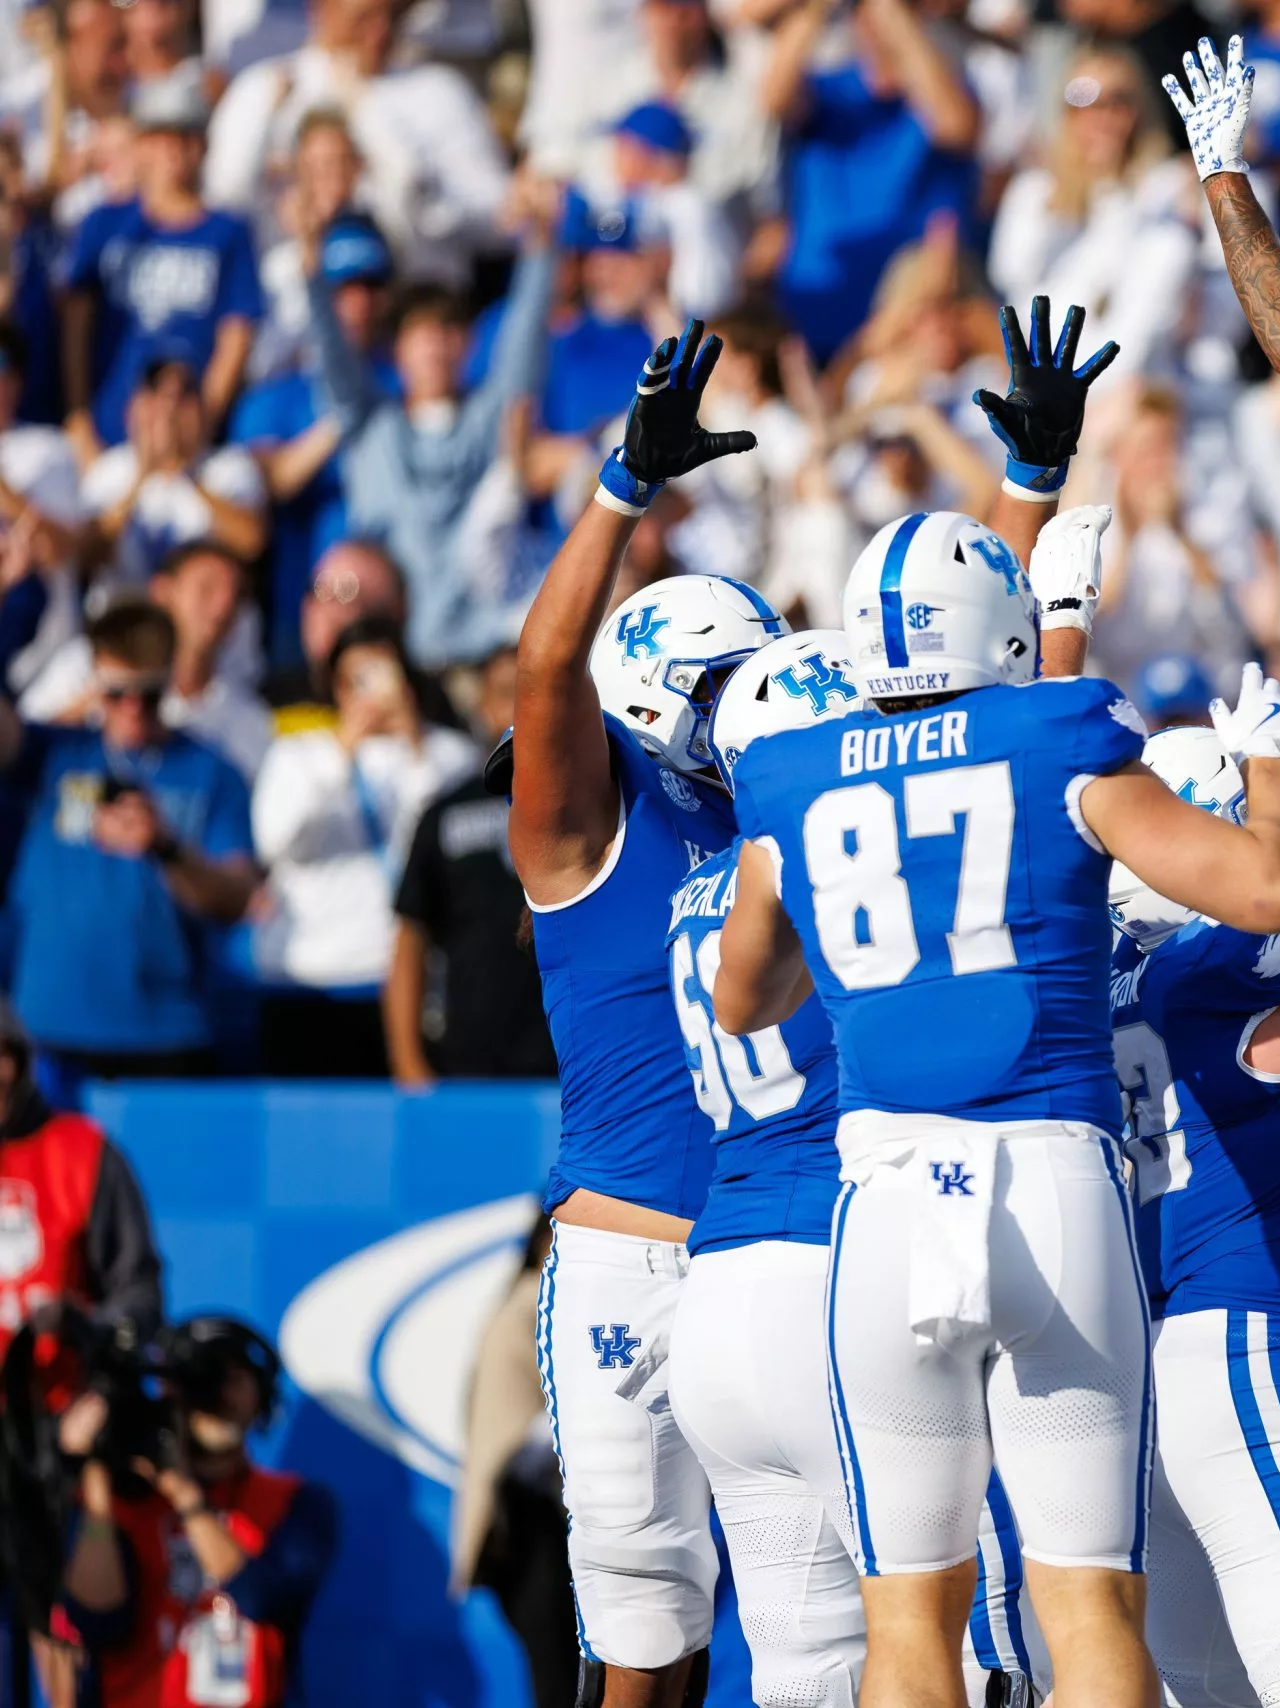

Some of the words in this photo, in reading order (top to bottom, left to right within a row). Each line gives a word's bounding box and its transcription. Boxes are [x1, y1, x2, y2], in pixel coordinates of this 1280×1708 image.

[615, 602, 672, 666] UK
[907, 604, 932, 629] SEC
[770, 650, 860, 717] UK
[867, 672, 950, 695] KENTUCKY
[840, 711, 968, 777] BOYER
[802, 760, 1017, 991] 87
[928, 1160, 976, 1197] UK
[588, 1323, 642, 1370] UK
